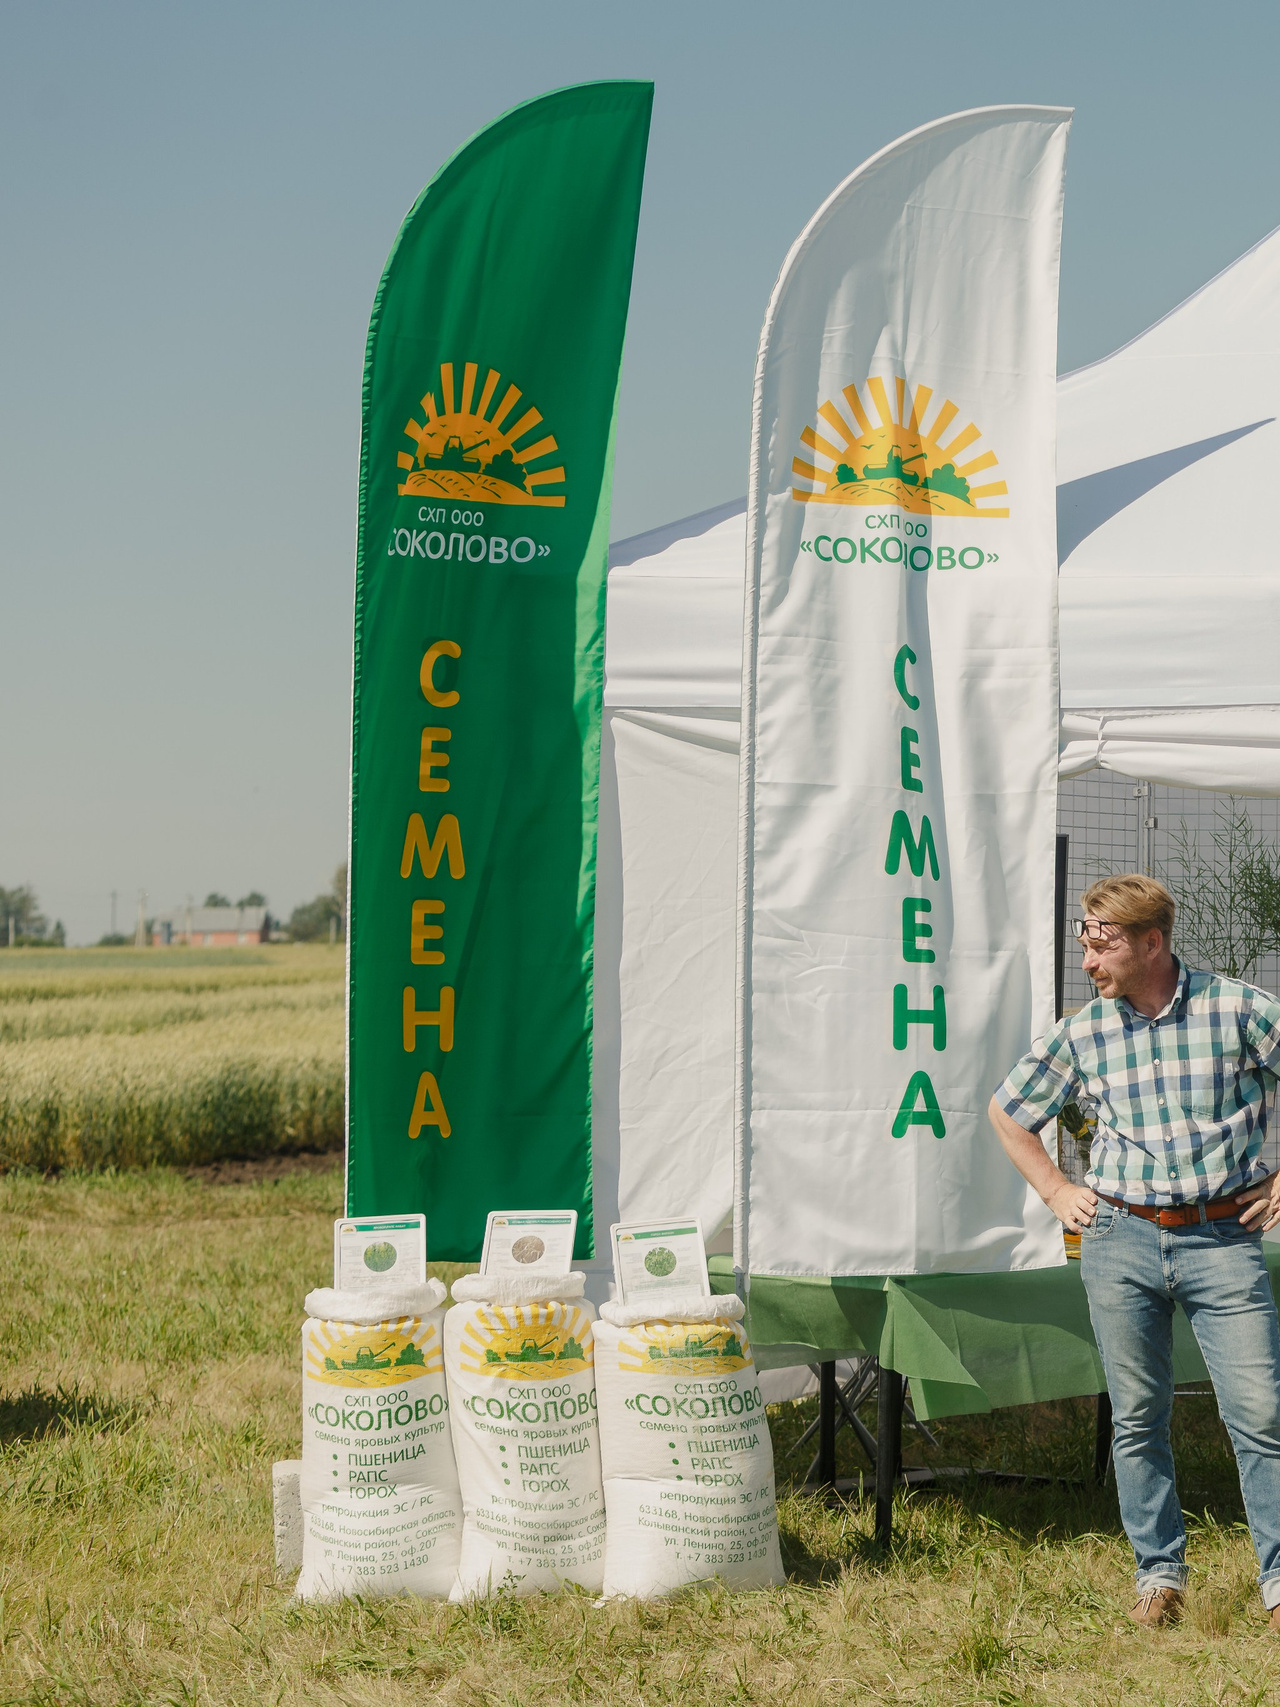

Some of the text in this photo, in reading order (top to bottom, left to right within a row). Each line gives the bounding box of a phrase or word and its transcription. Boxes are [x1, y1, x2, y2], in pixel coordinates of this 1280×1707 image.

[418, 506, 485, 527] СХП ООО
[865, 514, 900, 529] СХП
[400, 640, 466, 1139] СЕМЕНА
[884, 643, 947, 1139] СЕМЕНА
[508, 1384, 571, 1399] СХП ООО
[674, 1380, 737, 1395] СХП ООО
[345, 1390, 408, 1407] СХП ООО
[315, 1421, 445, 1449] семена яровых культур
[474, 1422, 518, 1438] семена
[523, 1428, 568, 1441] яровых
[640, 1420, 688, 1433] семена
[693, 1423, 737, 1436] яровых
[518, 1437, 590, 1459] ПШЕНИЦА
[688, 1434, 760, 1453] ПШЕНИЦА
[348, 1443, 426, 1466] ПШЕНИЦА
[520, 1462, 560, 1475] РАПС
[691, 1457, 733, 1470] РАПС
[349, 1470, 388, 1482] РАПС
[695, 1473, 743, 1486] ГОРОХ
[350, 1484, 398, 1499] ГОРОХ
[522, 1479, 570, 1492] ГОРОХ
[568, 1498, 579, 1509] ЭС
[589, 1490, 599, 1502] РС
[660, 1492, 736, 1506] репродукция
[740, 1493, 752, 1504] ЭС
[760, 1487, 769, 1498] РС
[322, 1504, 389, 1519] репродукция
[394, 1502, 408, 1514] ЭС
[420, 1494, 434, 1507] РС
[639, 1504, 760, 1525] 633168, Новосибирская
[311, 1510, 455, 1537] 633168, Новосибирская область
[365, 1539, 400, 1551] район,
[664, 1537, 678, 1546] ул.
[683, 1538, 726, 1551] Ленина,
[338, 1550, 378, 1563] Ленина,
[356, 1566, 376, 1575] 383
[380, 1564, 399, 1575] 523
[403, 1554, 429, 1570] 1430
[686, 1553, 700, 1562] +7
[705, 1553, 724, 1563] 383
[727, 1552, 744, 1563] 523
